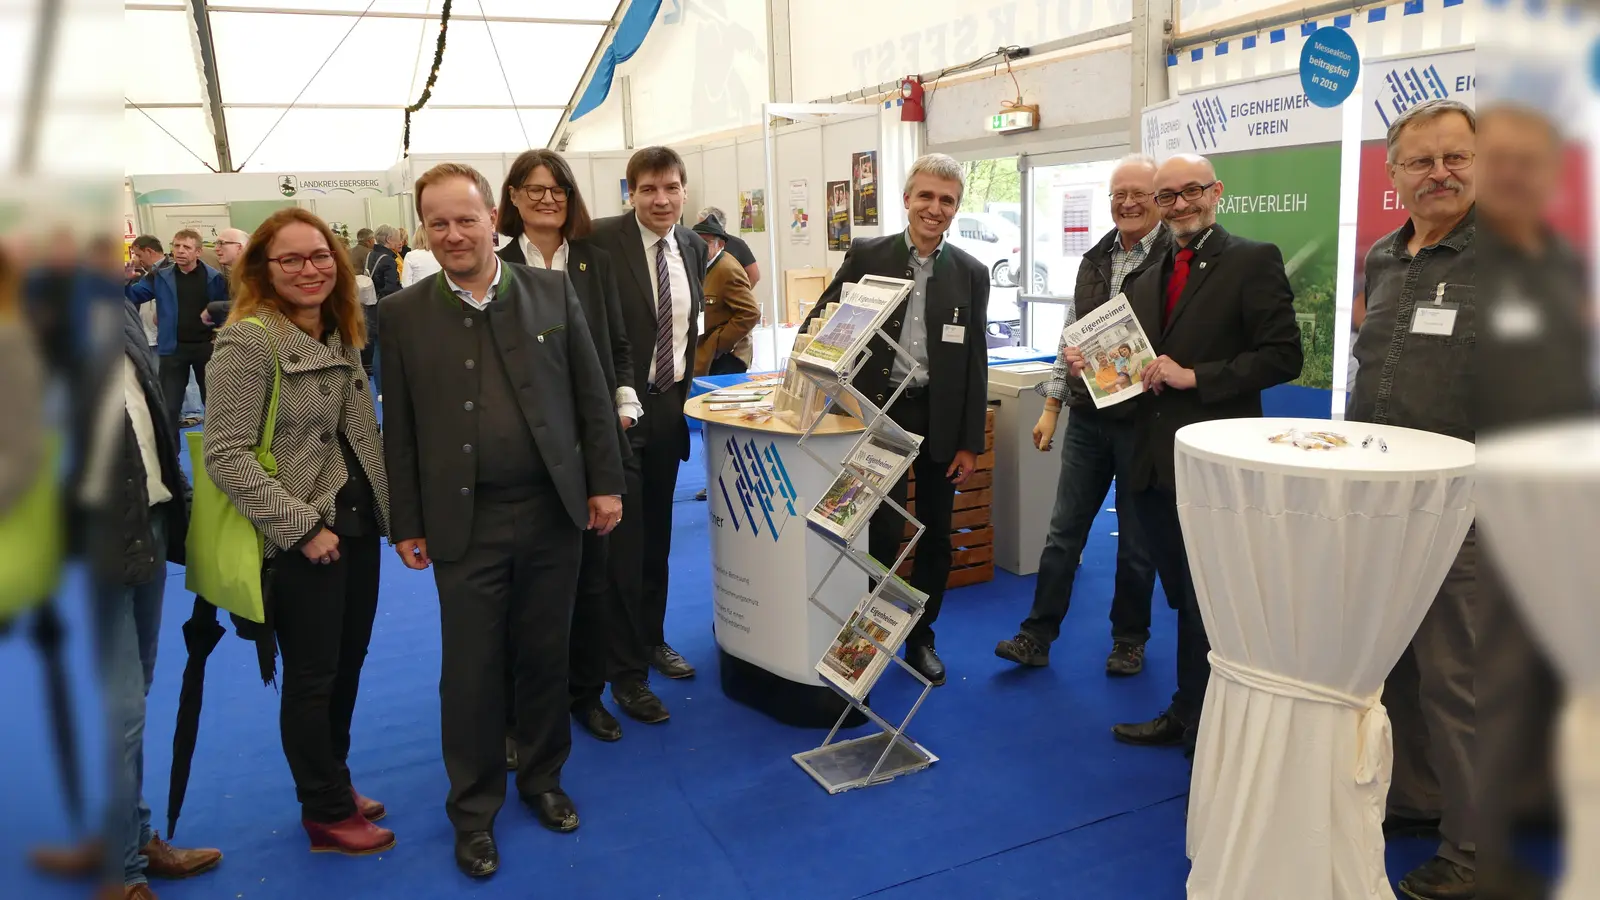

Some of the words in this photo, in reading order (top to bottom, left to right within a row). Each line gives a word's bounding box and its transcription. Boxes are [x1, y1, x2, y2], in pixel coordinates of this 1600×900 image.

[1314, 41, 1352, 61] Messeaktion
[1308, 54, 1351, 78] beitragsfrei
[1311, 73, 1320, 84] in
[1319, 77, 1339, 92] 2019
[1230, 93, 1310, 118] EIGENHEIMER
[1247, 118, 1289, 137] VEREIN
[299, 180, 339, 189] LANDKREIS
[339, 179, 379, 188] EBERSBERG
[1214, 193, 1308, 215] RÄTEVERLEIH
[1383, 190, 1405, 210] EI
[1080, 302, 1127, 335] Eigenheimer
[865, 454, 894, 471] Eigenheimer
[870, 606, 899, 628] Eigenheimer
